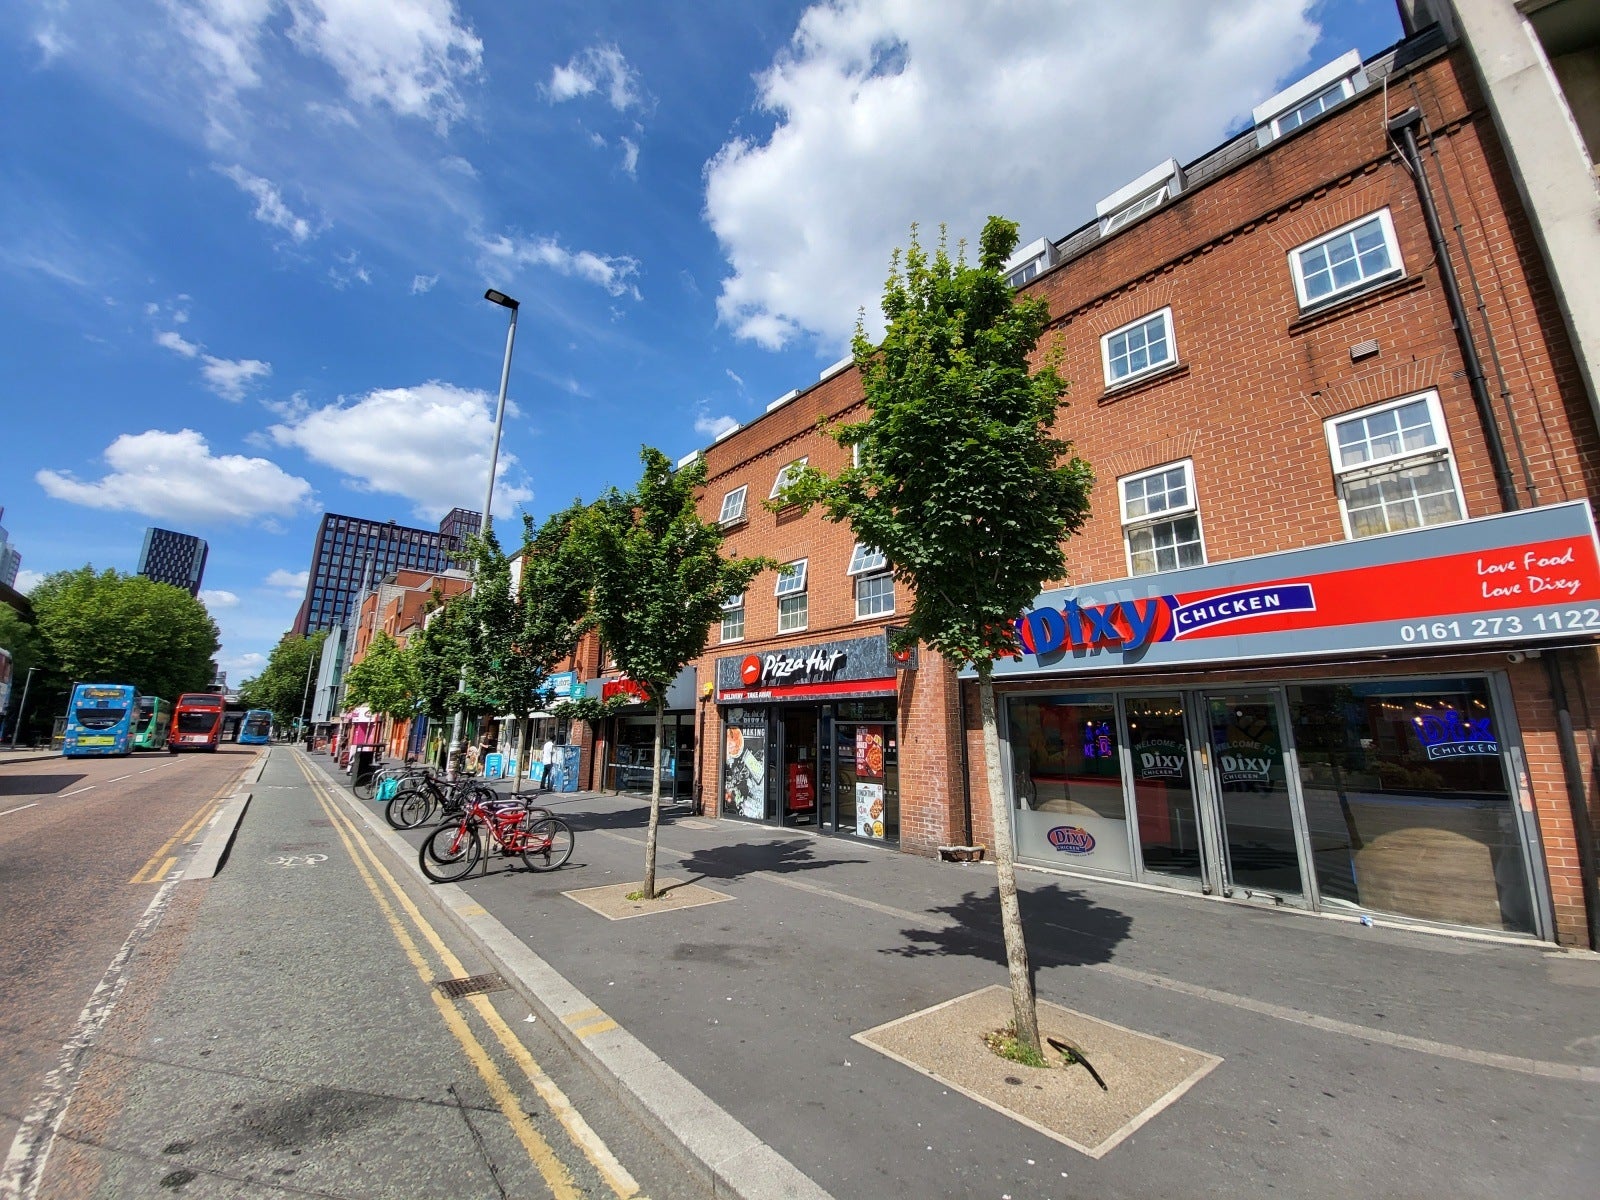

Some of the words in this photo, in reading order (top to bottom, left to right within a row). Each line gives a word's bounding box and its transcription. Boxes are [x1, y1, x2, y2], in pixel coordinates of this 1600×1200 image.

[1477, 559, 1516, 576] Love
[1523, 547, 1574, 570] Food
[1481, 581, 1521, 598] Love
[1528, 576, 1581, 595] Dixy
[1179, 593, 1281, 625] CHICKEN
[1027, 597, 1157, 654] Dixy
[1400, 621, 1461, 642] 0161
[1471, 616, 1523, 637] 273
[1533, 608, 1600, 631] 1122
[762, 654, 805, 680] Pizza
[805, 649, 843, 674] Hut
[742, 728, 766, 737] MAKING
[1412, 709, 1495, 746] Dix
[1135, 739, 1176, 751] WELCOME
[1213, 740, 1262, 753] WELCOME
[1263, 744, 1276, 755] TO
[1431, 744, 1497, 756] CHICKEN
[1140, 750, 1185, 771] Dixy
[1220, 752, 1272, 775] Dixy
[1055, 829, 1089, 847] Dixy
